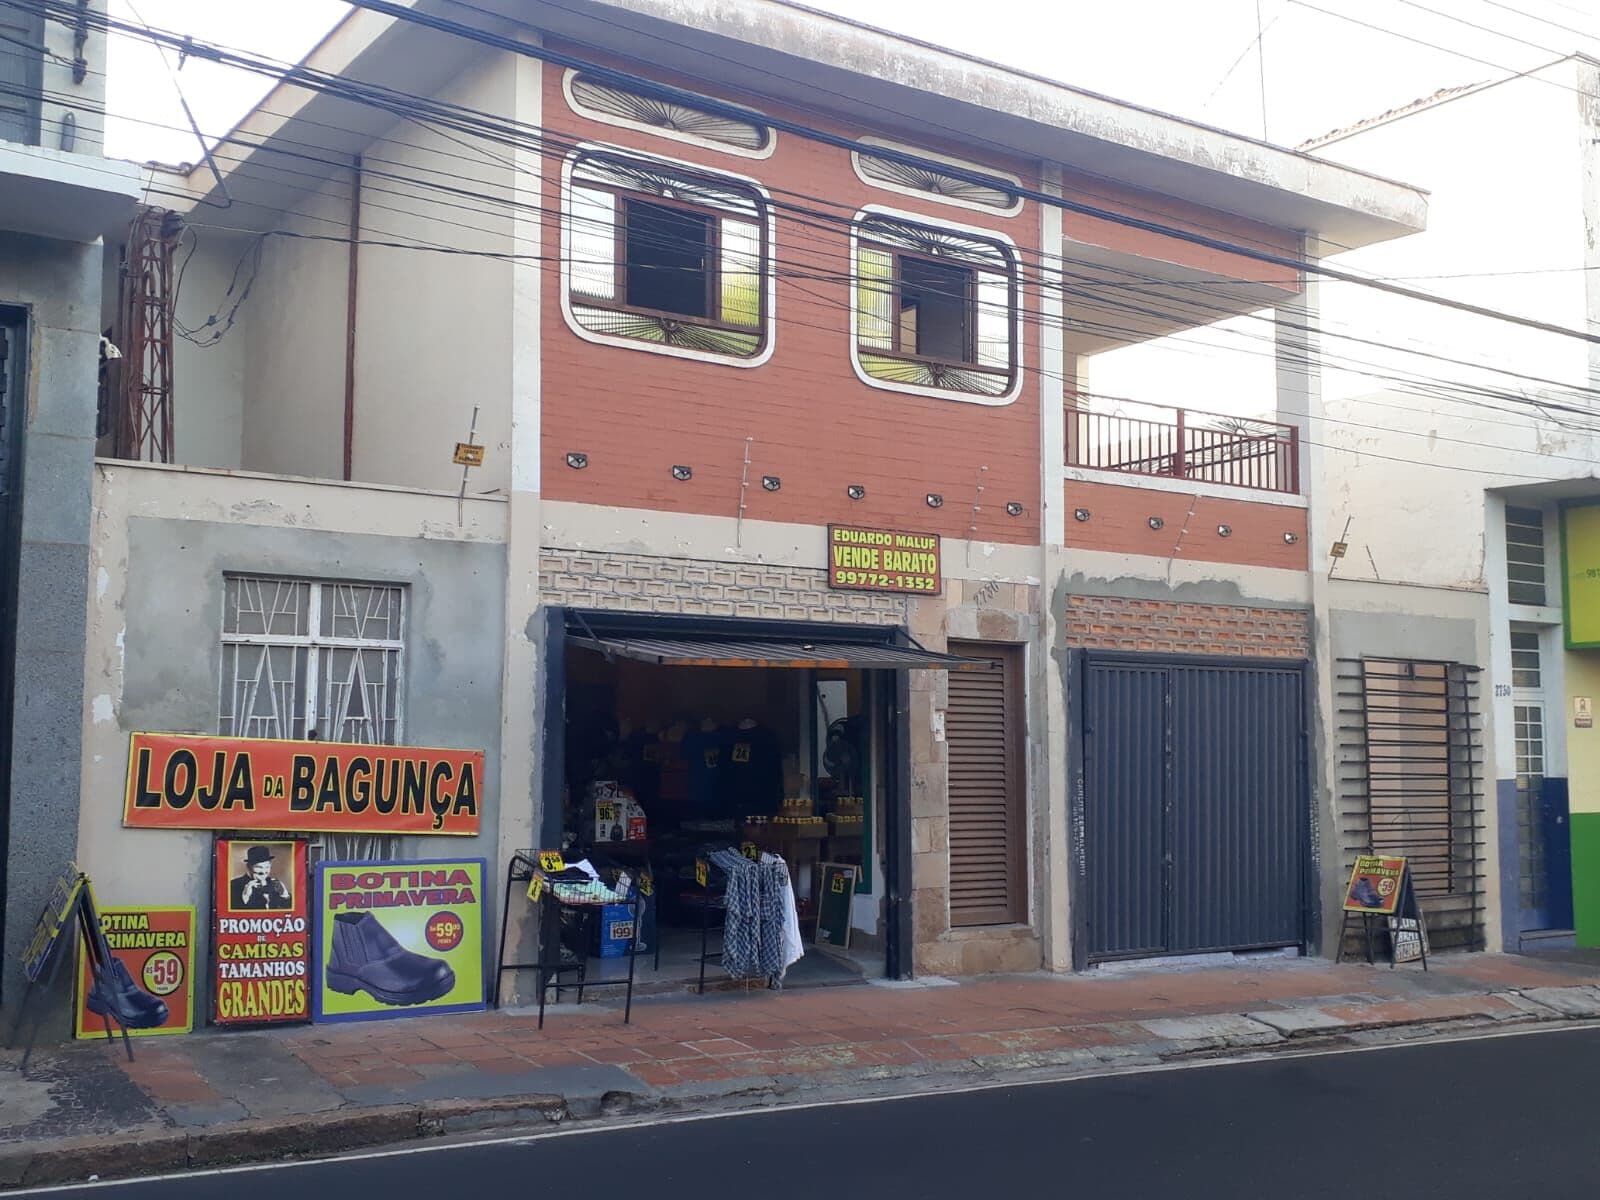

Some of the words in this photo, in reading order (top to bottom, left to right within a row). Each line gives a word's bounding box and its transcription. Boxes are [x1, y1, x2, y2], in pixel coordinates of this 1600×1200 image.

[833, 529, 892, 546] EDUARDO
[895, 534, 936, 550] MALUF
[833, 545, 879, 570] VENDE
[883, 551, 937, 575] BARATO
[836, 571, 935, 590] 99772-1352
[134, 747, 255, 811] LOJA
[264, 775, 284, 798] DA
[289, 754, 478, 830] BAGUNÇA
[330, 869, 473, 890] BOTINA
[329, 888, 476, 909] PRIMAVERA
[100, 914, 149, 931] OTINA
[219, 914, 305, 936] PROMOÇÃO
[219, 942, 305, 959] CAMISAS
[153, 958, 178, 985] 59
[219, 961, 305, 978] TAMANHOS
[219, 979, 305, 1017] GRANDES
